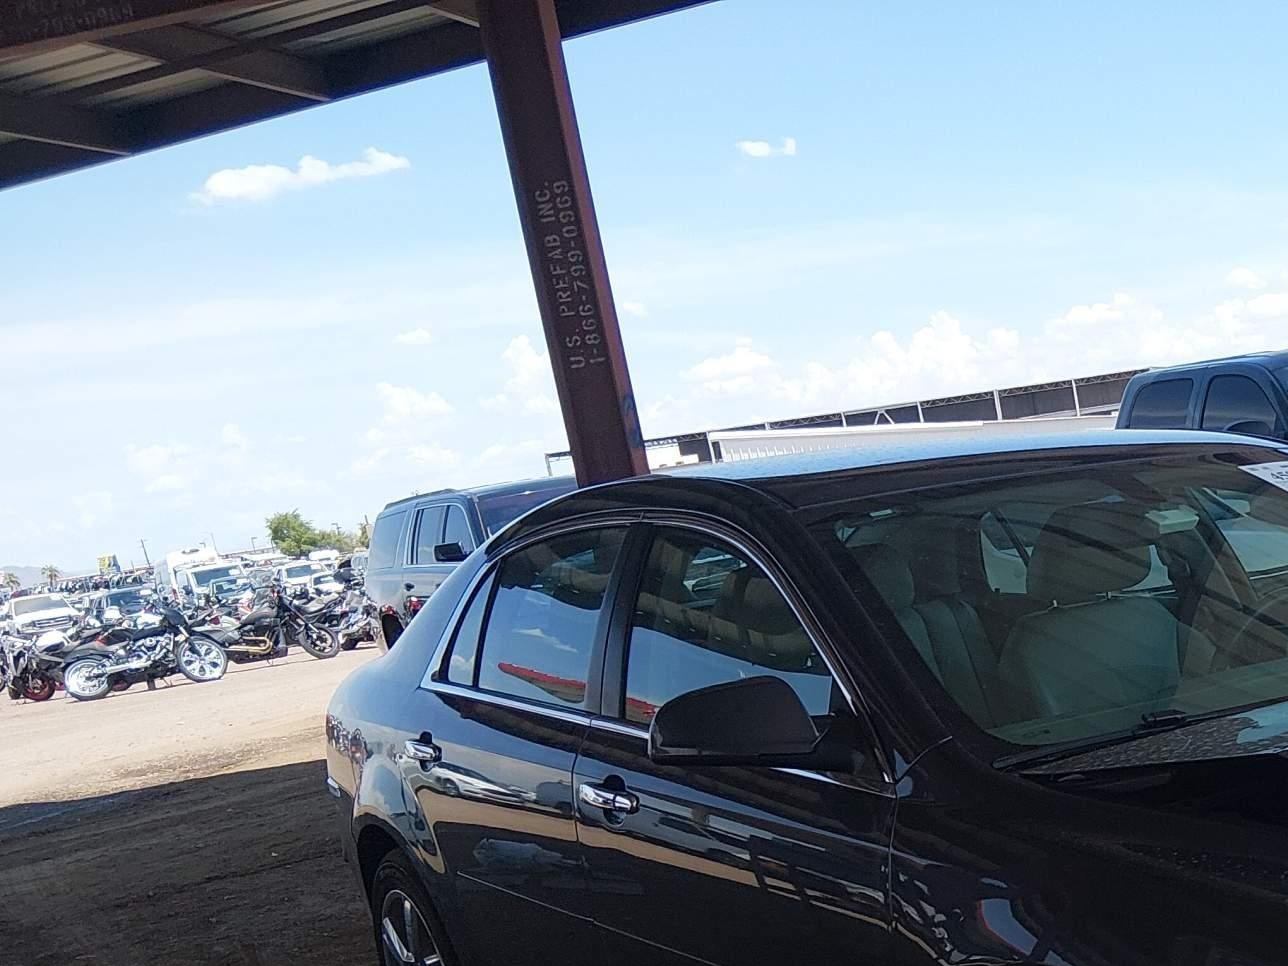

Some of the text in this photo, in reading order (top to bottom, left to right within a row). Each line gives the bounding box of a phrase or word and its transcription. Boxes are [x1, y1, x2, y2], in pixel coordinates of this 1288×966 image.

[534, 181, 586, 369] U.S. PREFAB INC.
[552, 180, 606, 364] 1-866-799-0969
